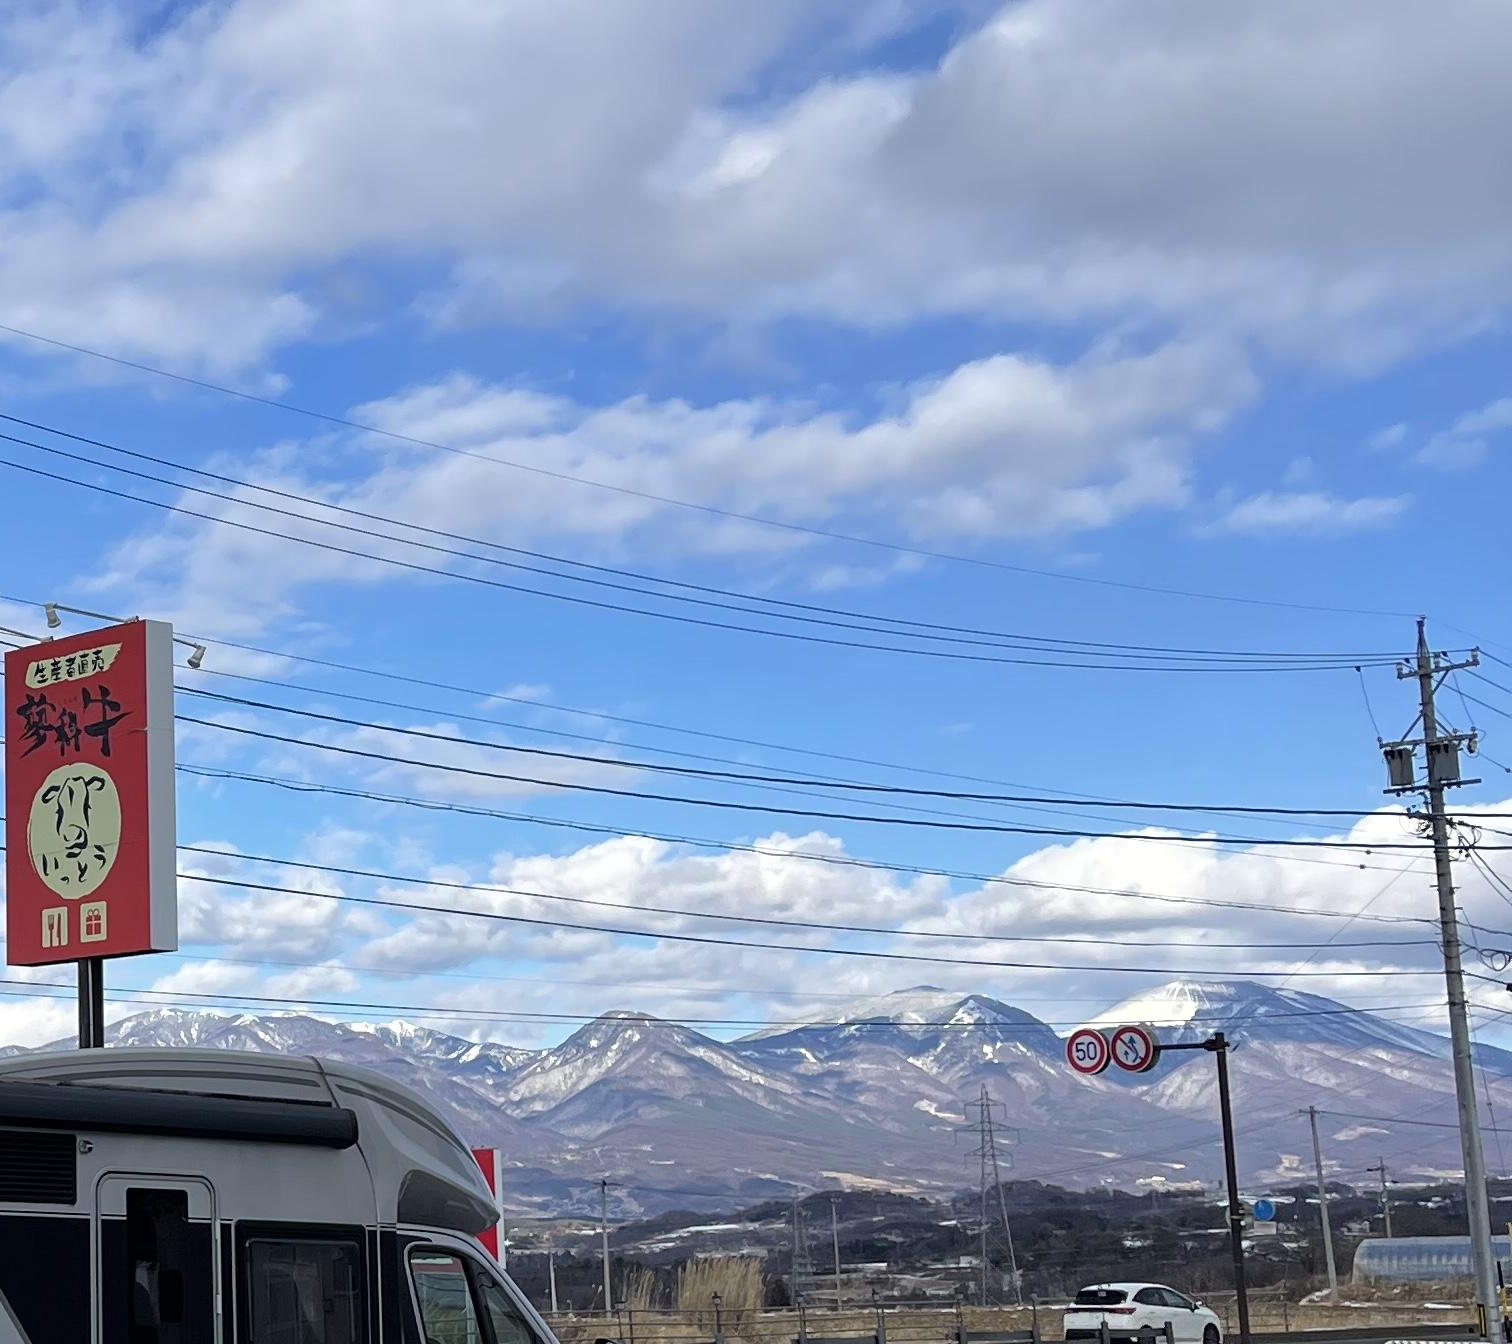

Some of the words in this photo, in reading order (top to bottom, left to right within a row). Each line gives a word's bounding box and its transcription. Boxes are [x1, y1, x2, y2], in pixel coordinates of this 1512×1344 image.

[34, 650, 105, 685] 生産者直売
[42, 844, 107, 885] いっとう
[1075, 1041, 1098, 1061] 50
